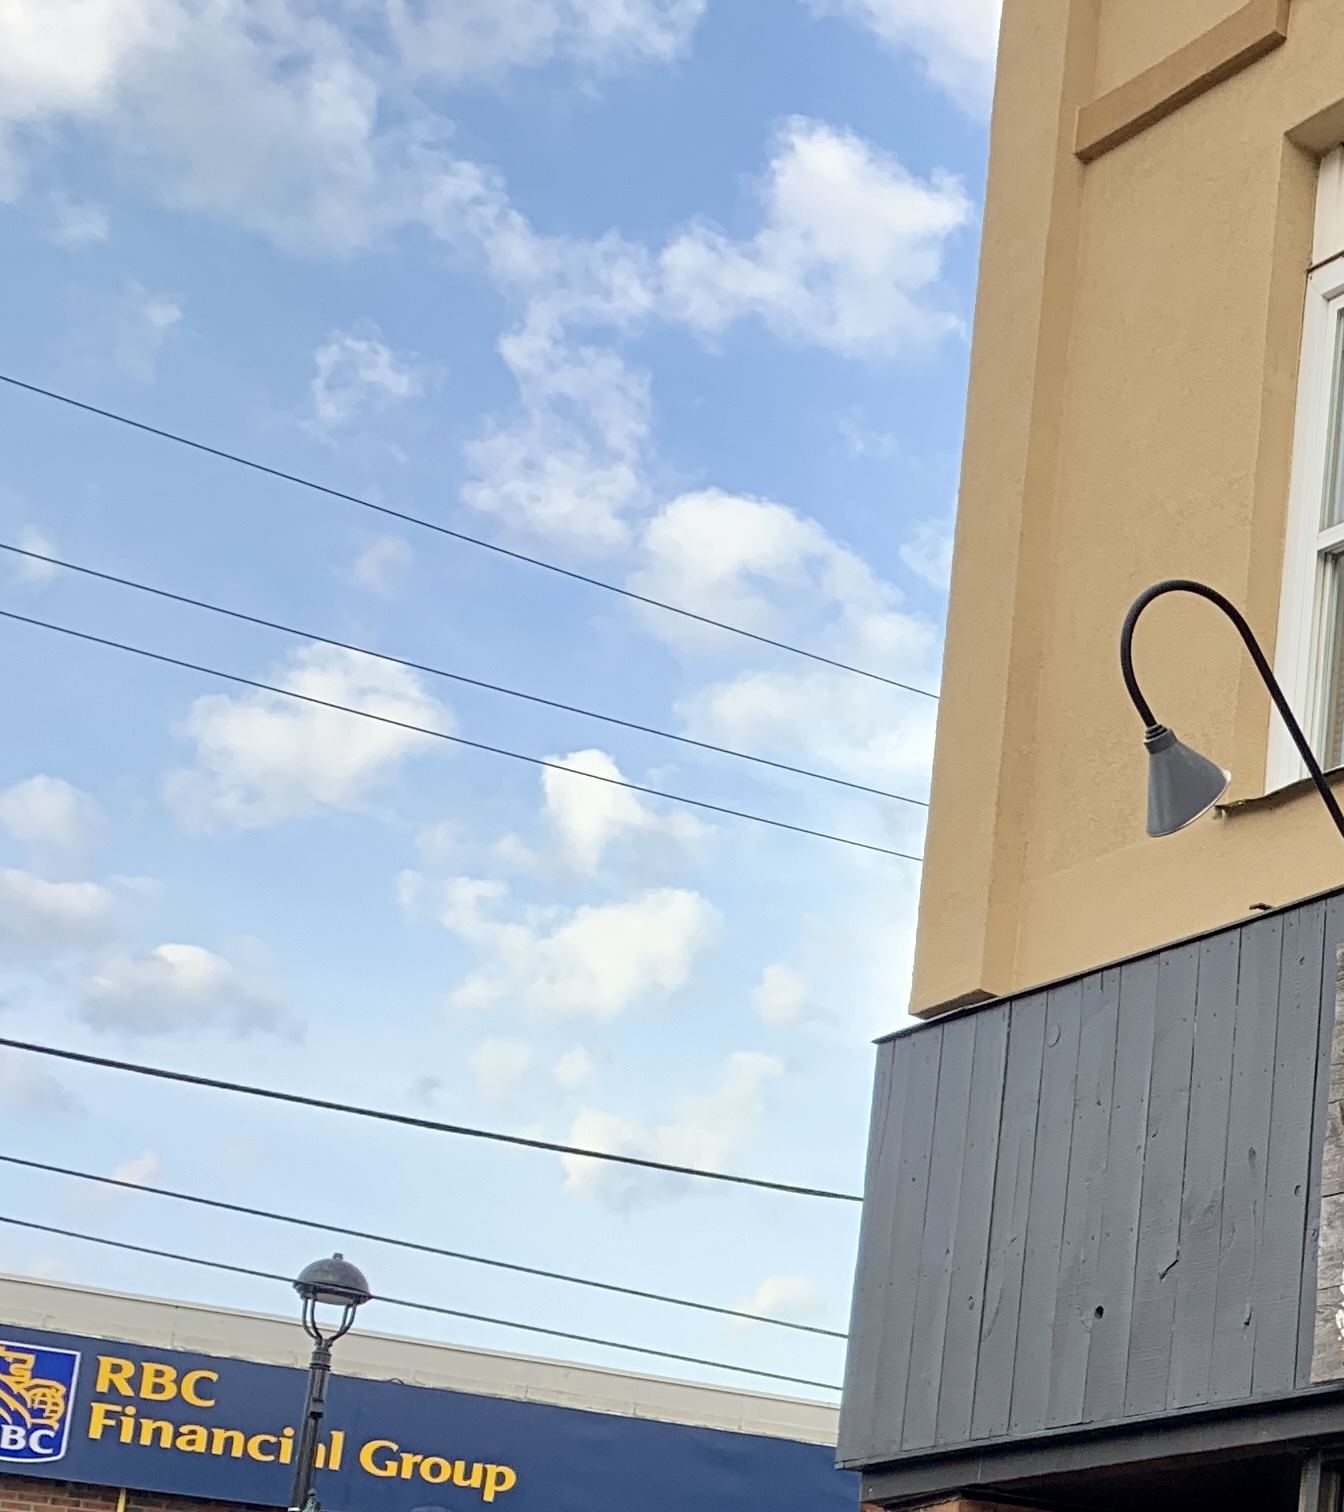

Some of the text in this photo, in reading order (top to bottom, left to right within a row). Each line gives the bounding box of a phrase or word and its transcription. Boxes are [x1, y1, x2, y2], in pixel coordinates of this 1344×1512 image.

[95, 1355, 218, 1407] RBC
[0, 1424, 56, 1456] BC
[358, 1442, 516, 1502] Group
